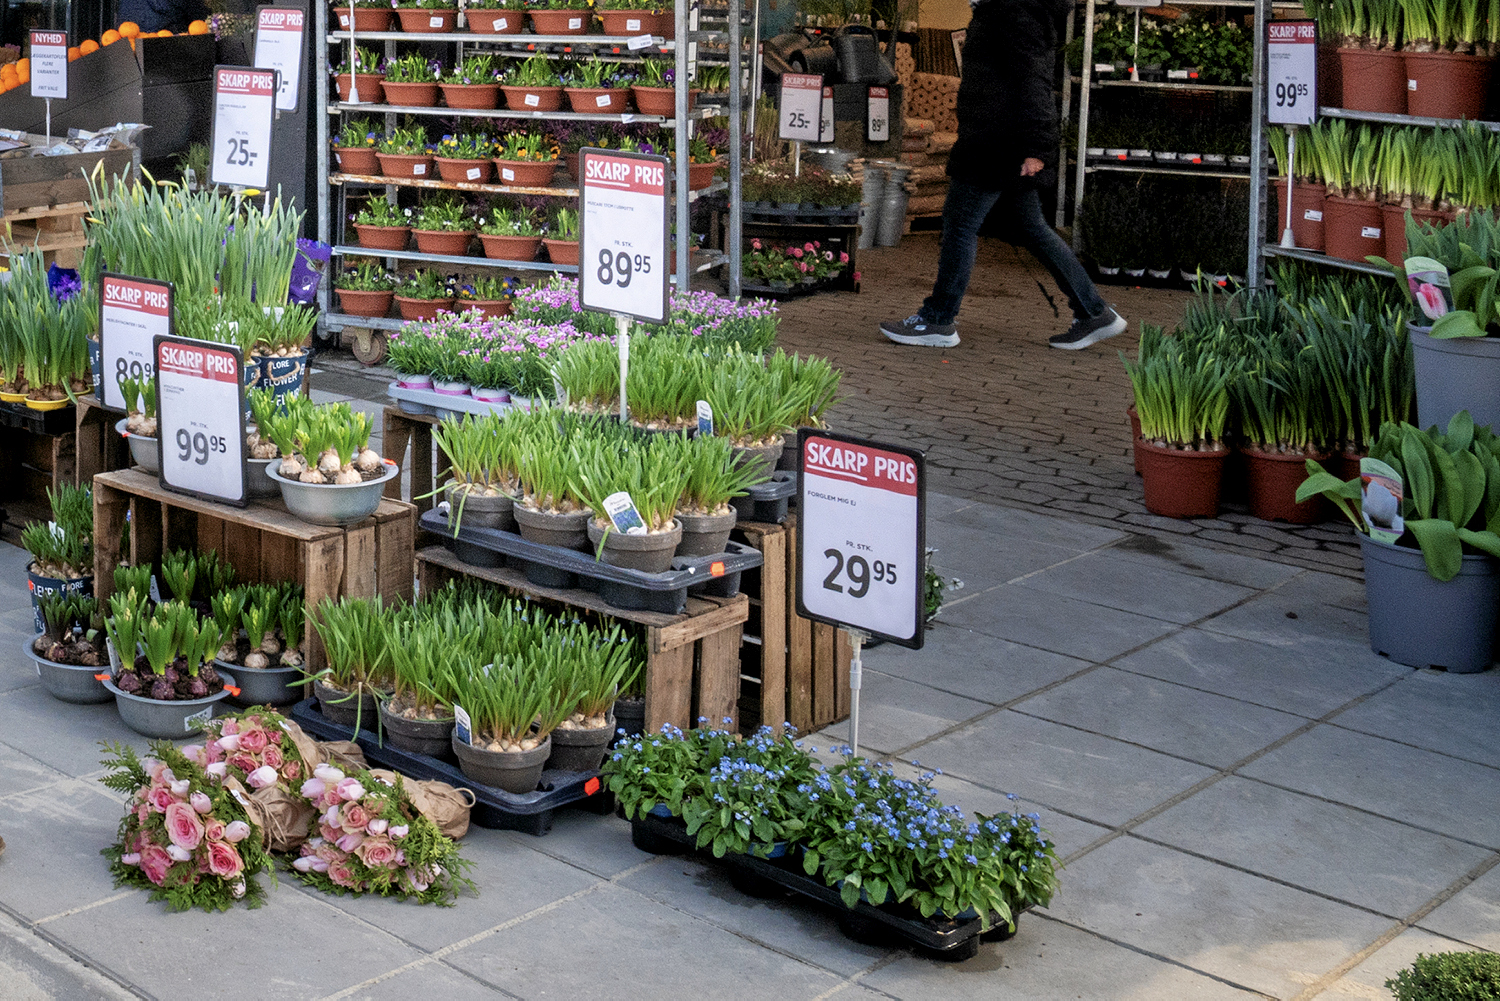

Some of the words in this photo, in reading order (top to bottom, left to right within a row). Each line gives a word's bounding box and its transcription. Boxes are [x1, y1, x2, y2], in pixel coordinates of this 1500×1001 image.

[260, 12, 284, 26] SKARP
[286, 13, 303, 26] PRIS
[35, 33, 62, 44] NYHED
[1270, 26, 1296, 38] SKARP
[1297, 26, 1315, 38] PRIS
[219, 73, 250, 88] SKARP
[252, 75, 273, 90] PRIS
[784, 76, 805, 85] SKARP
[806, 78, 821, 87] PRIS
[586, 159, 630, 182] SKARP
[635, 165, 664, 187] PRIS
[105, 284, 142, 303] SKARP
[144, 291, 168, 309] PRIS
[162, 346, 203, 369] SKARP
[206, 354, 235, 375] PRIS
[263, 374, 298, 387] FLOWER
[807, 442, 868, 473] SKARP
[874, 456, 916, 485] PRIS
[807, 490, 836, 501] FORGLEM
[846, 540, 856, 549] PR.
[856, 543, 873, 552] STK.
